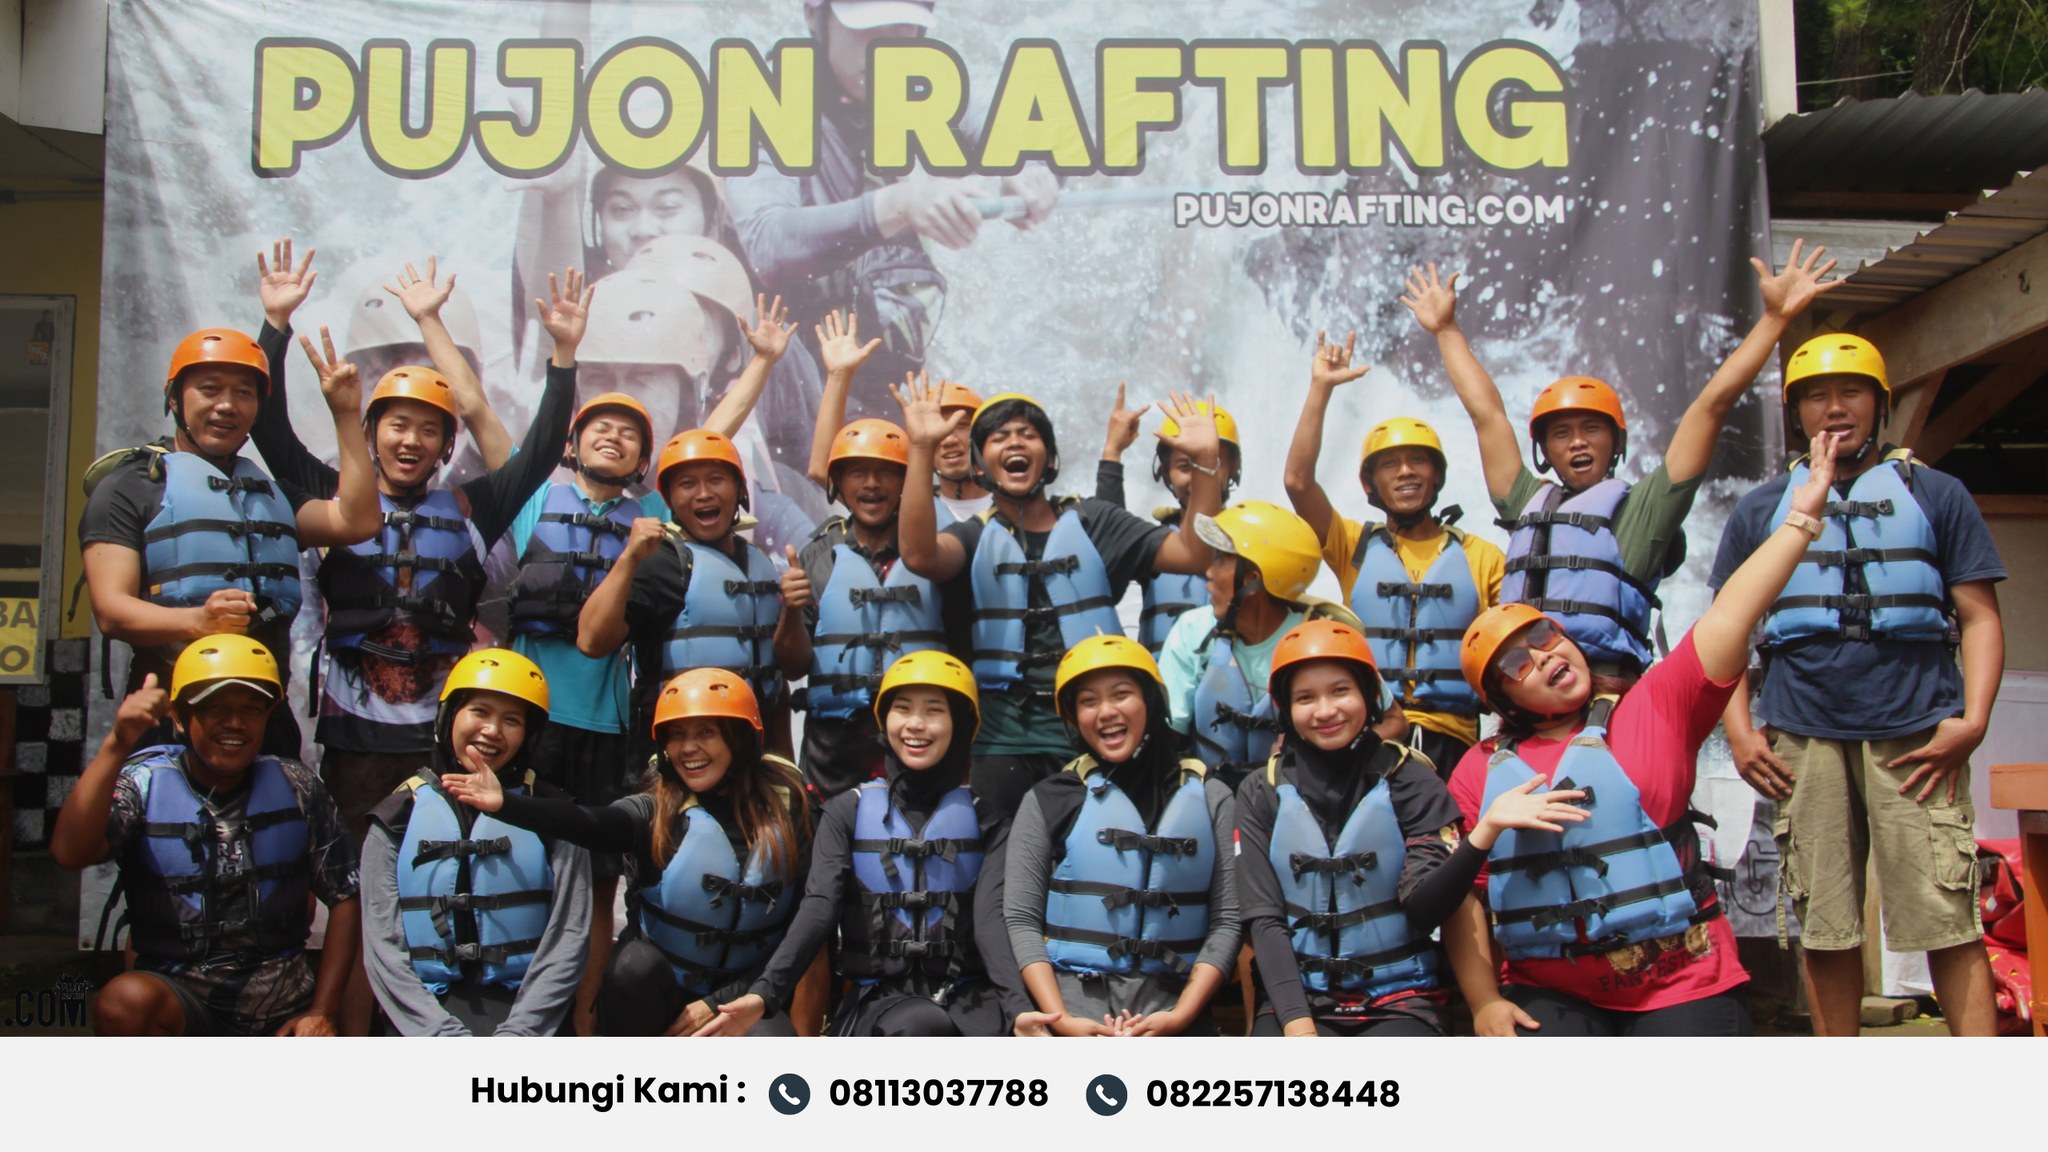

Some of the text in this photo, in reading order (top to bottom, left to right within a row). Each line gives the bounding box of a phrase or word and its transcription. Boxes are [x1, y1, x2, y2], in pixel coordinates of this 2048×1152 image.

[252, 37, 1572, 179] PUJON RAFTING
[1174, 192, 1567, 228] PUJONRAFTING.COM
